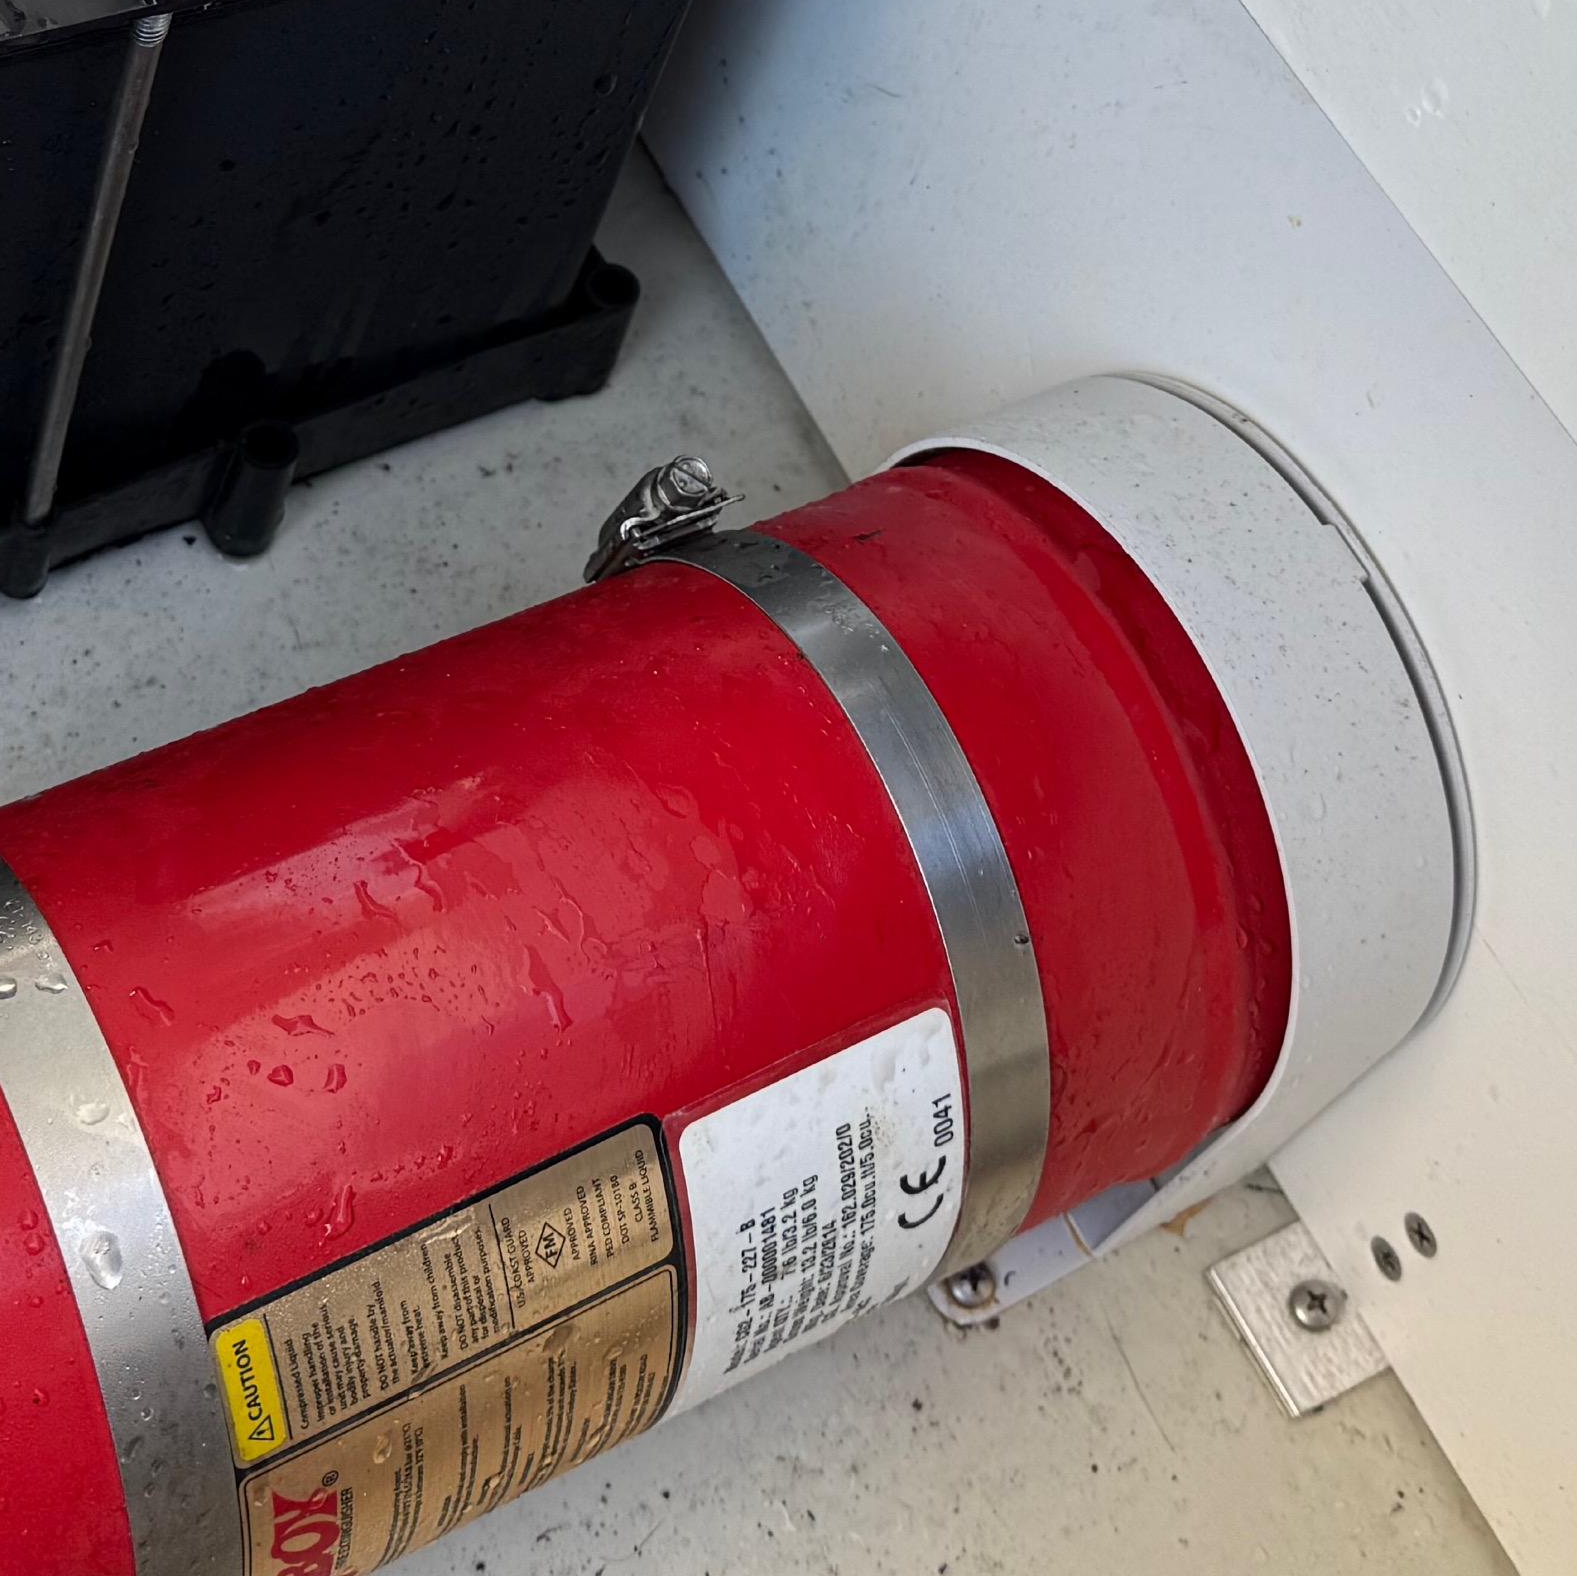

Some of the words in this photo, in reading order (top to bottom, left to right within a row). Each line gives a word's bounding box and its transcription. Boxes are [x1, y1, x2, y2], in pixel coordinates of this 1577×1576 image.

[932, 1091, 953, 1148] 0041
[634, 1147, 649, 1185] LIQUID
[801, 1173, 817, 1196] kg
[575, 1183, 593, 1240] APPROVED
[591, 1175, 610, 1237] COMPLIANT
[630, 1189, 643, 1223] CLASS
[781, 1186, 797, 1209] kg
[501, 1215, 516, 1254] GUARD
[563, 1205, 580, 1262] APPROVED
[618, 1221, 629, 1244] DOT
[801, 1196, 817, 1242] lb/6.0
[518, 1228, 535, 1284] APPROVED
[541, 1231, 557, 1260] FM
[603, 1235, 614, 1258] PED
[508, 1254, 522, 1289] COAST
[284, 1336, 299, 1372] Liquid
[231, 1338, 263, 1423] CAUTION
[290, 1370, 310, 1430] Compressed
